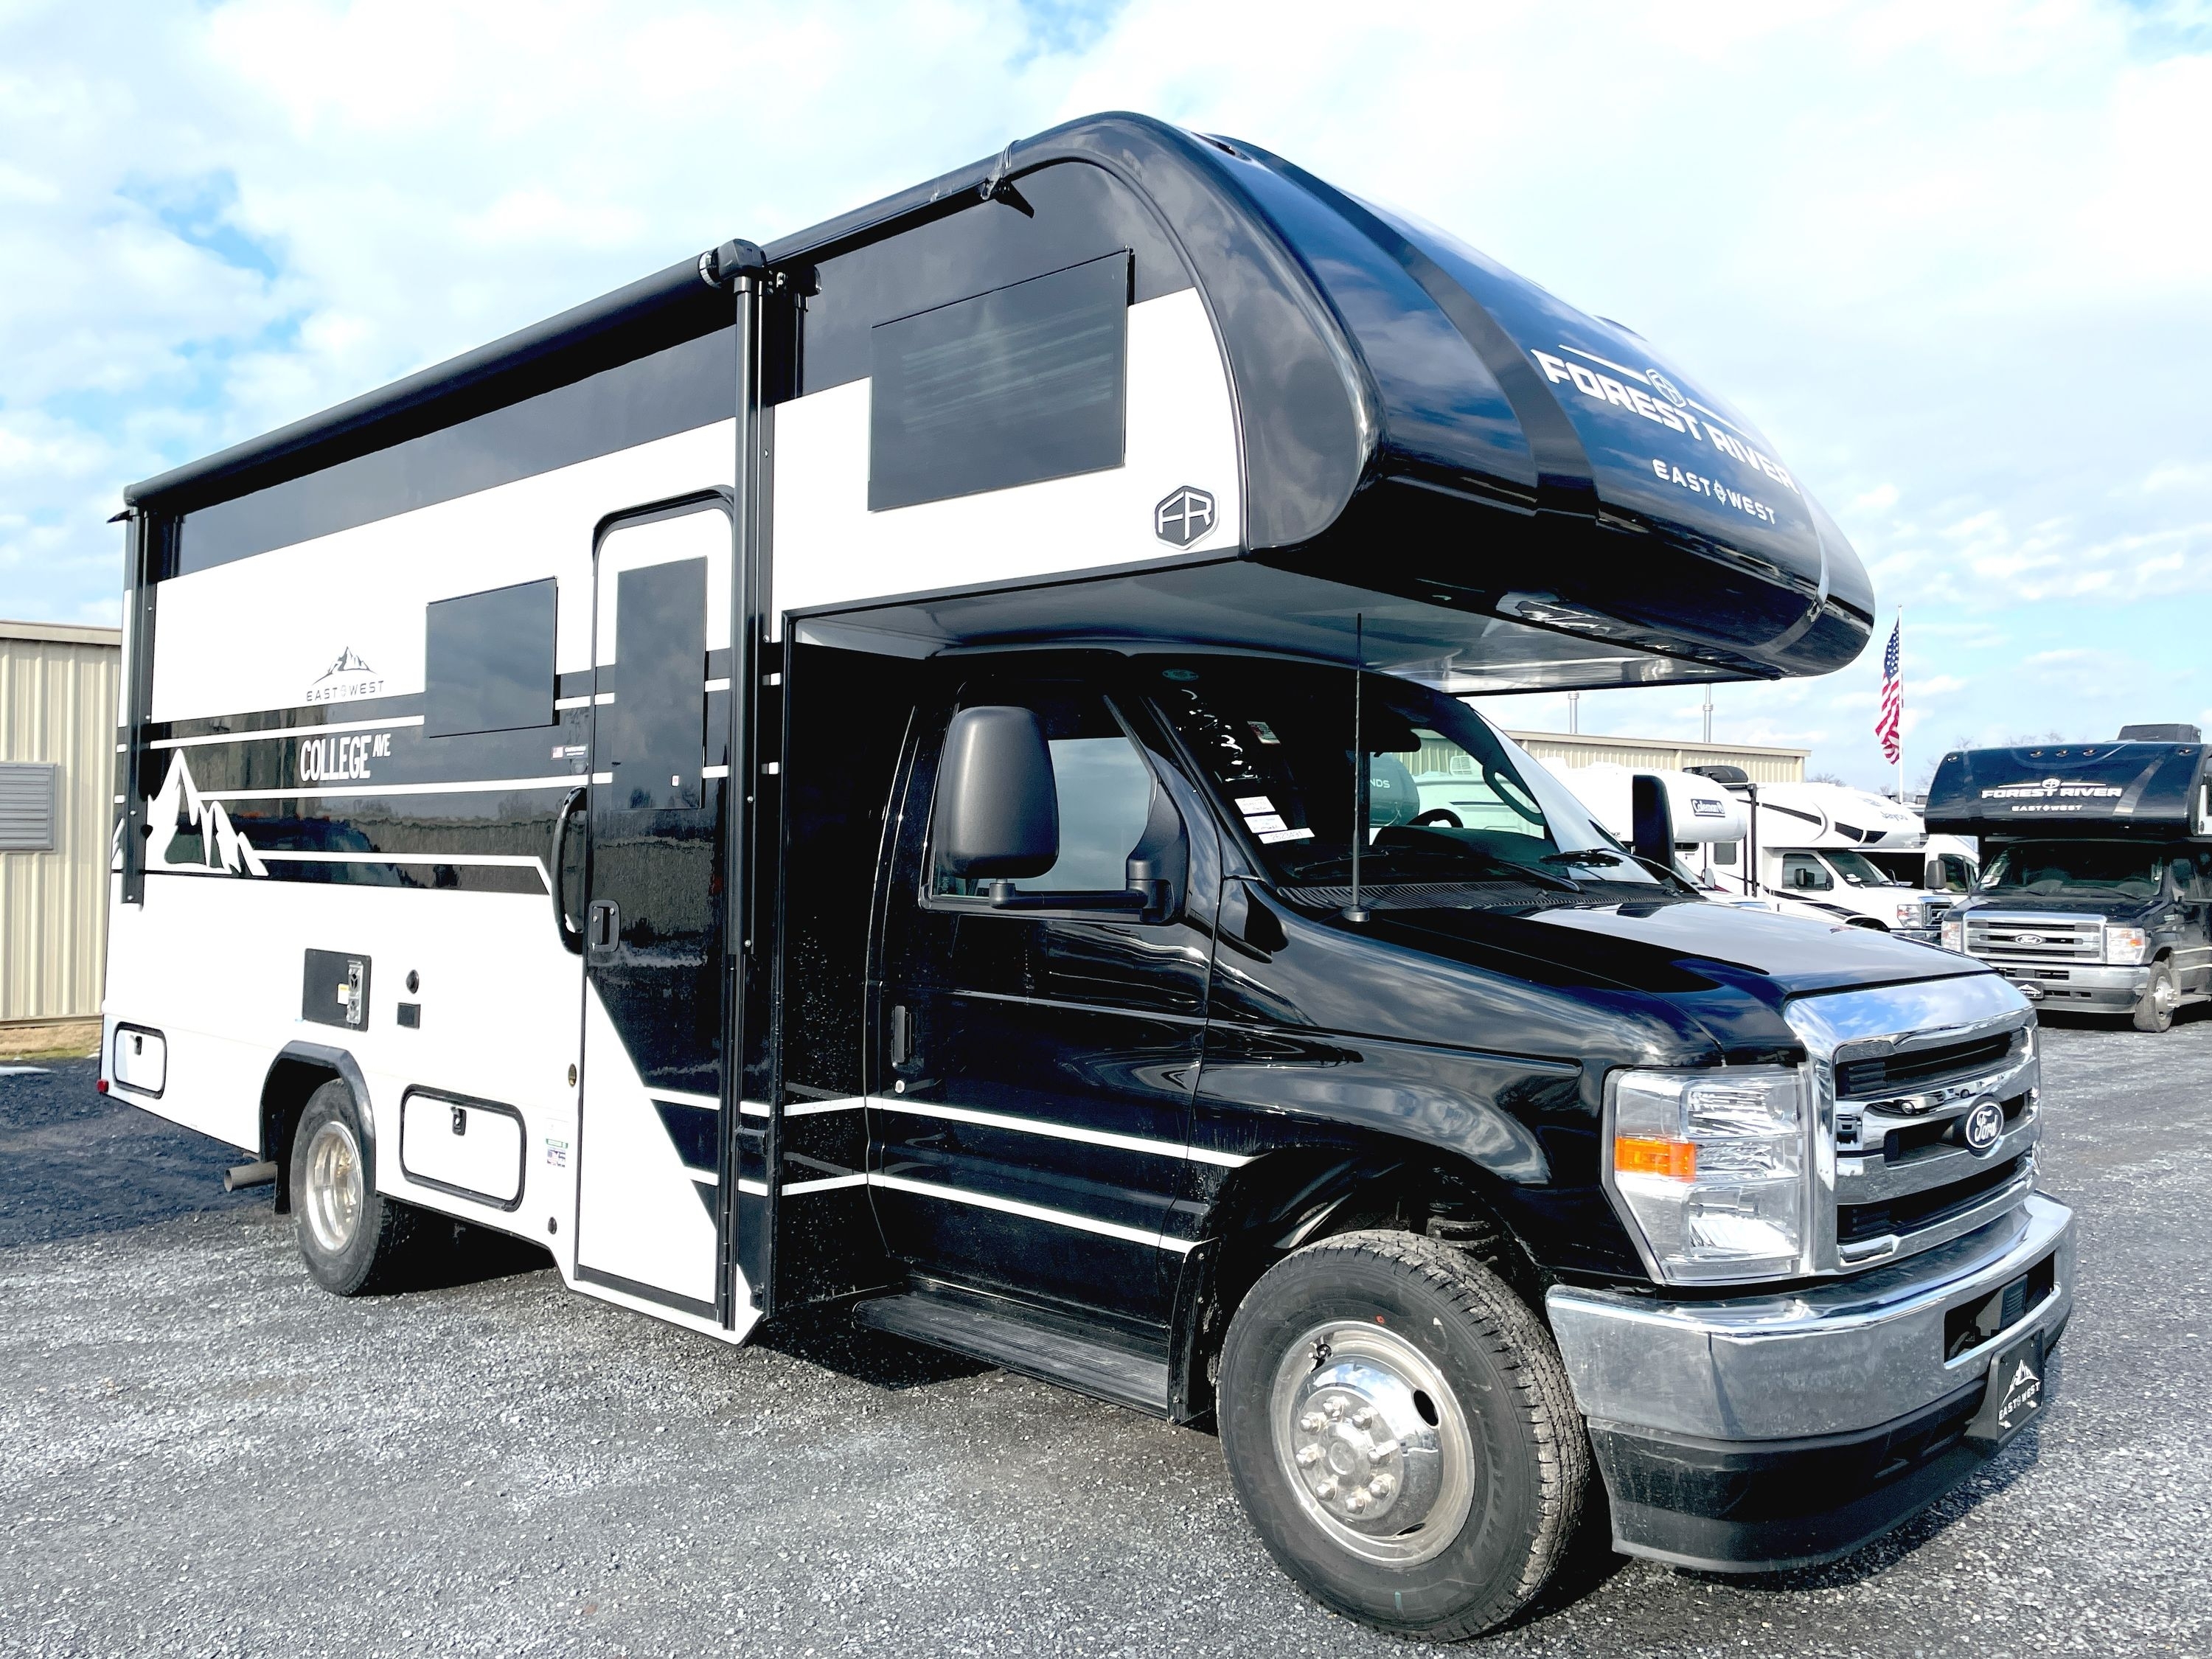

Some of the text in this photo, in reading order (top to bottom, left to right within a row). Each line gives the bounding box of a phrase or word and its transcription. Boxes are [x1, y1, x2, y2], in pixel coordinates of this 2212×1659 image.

[1531, 348, 1801, 495] FOREST RIVER
[1652, 459, 1776, 524] EAST WEST
[306, 680, 384, 701] EAST WEST
[299, 733, 392, 782] COLLEGE AVE
[1981, 787, 2123, 799] FOREST RIVER
[1975, 1109, 1998, 1142] Ford
[1998, 1381, 2041, 1421] EAST WEST
